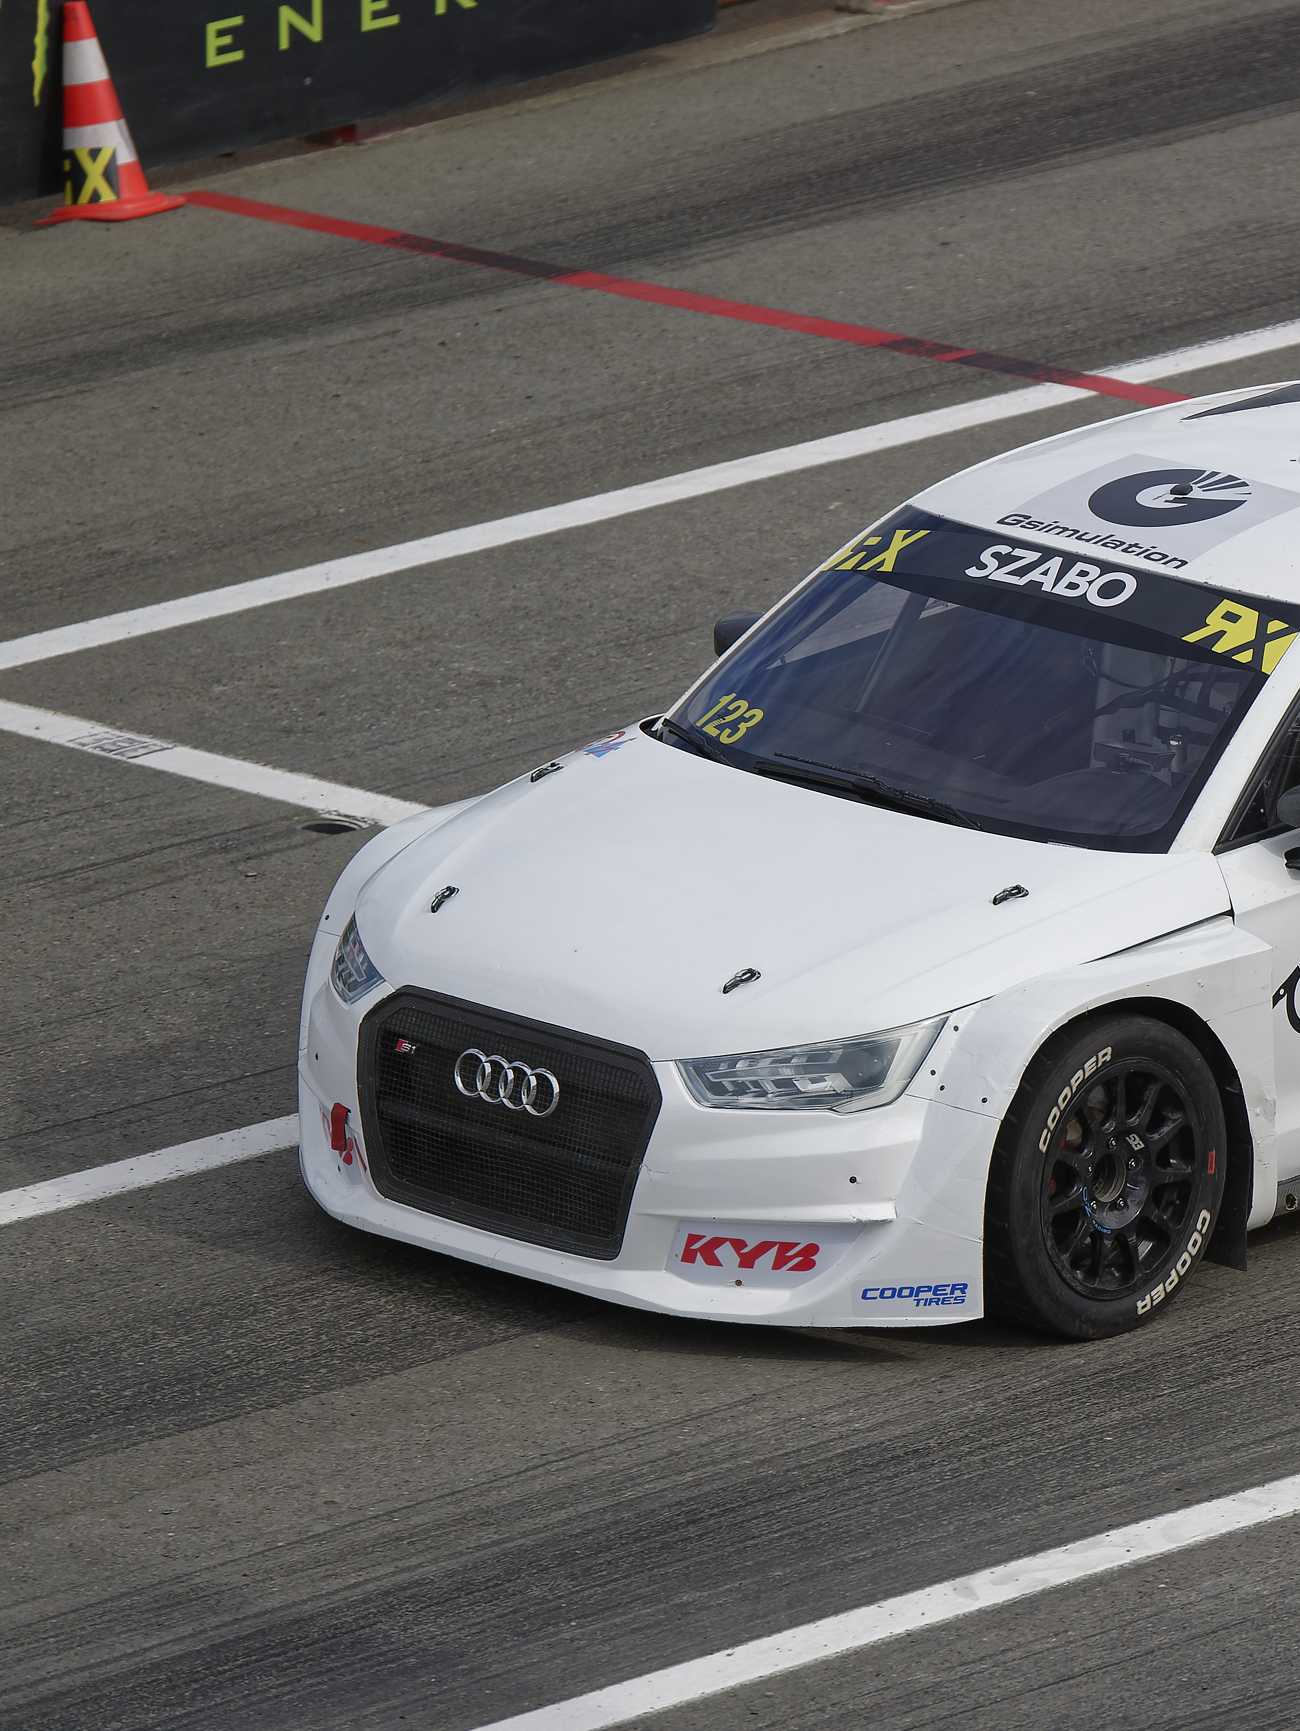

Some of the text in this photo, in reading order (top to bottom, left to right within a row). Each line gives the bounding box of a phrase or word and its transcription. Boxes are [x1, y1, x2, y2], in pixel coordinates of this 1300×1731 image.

[996, 512, 1189, 570] Gsimulation
[965, 544, 1137, 608] SZABO
[695, 692, 764, 745] 123
[1039, 1046, 1112, 1153] COOPER
[680, 1233, 820, 1272] KYB
[1136, 1208, 1211, 1315] COOPER
[861, 1282, 969, 1300] COOPER
[913, 1295, 966, 1307] TIRES
